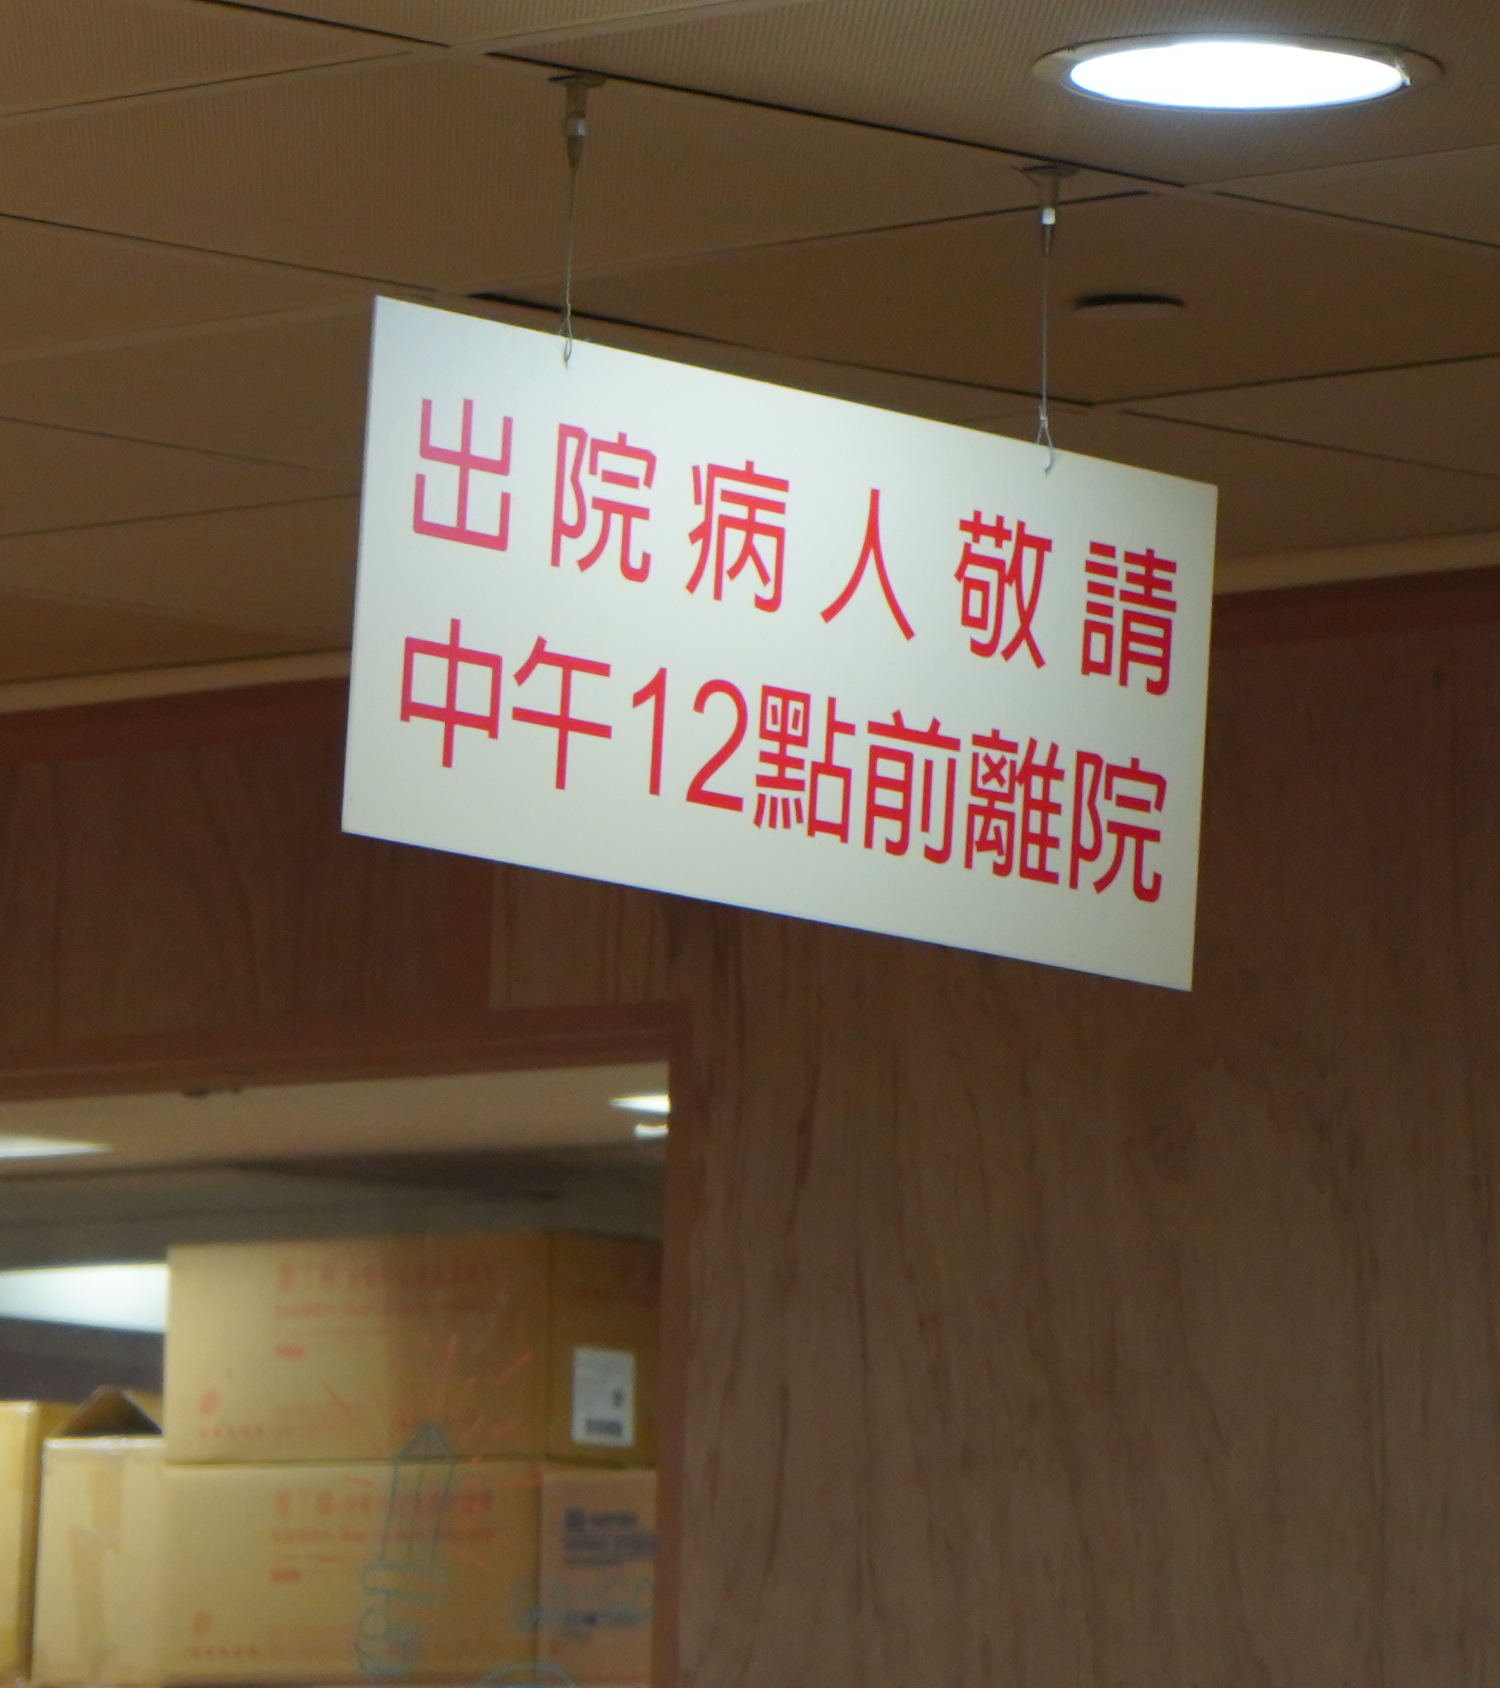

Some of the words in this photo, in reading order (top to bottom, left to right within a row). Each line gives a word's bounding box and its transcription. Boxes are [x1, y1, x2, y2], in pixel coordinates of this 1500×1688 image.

[412, 397, 1177, 696] 出院病人敬請
[399, 618, 1168, 904] 中午12點前離院
